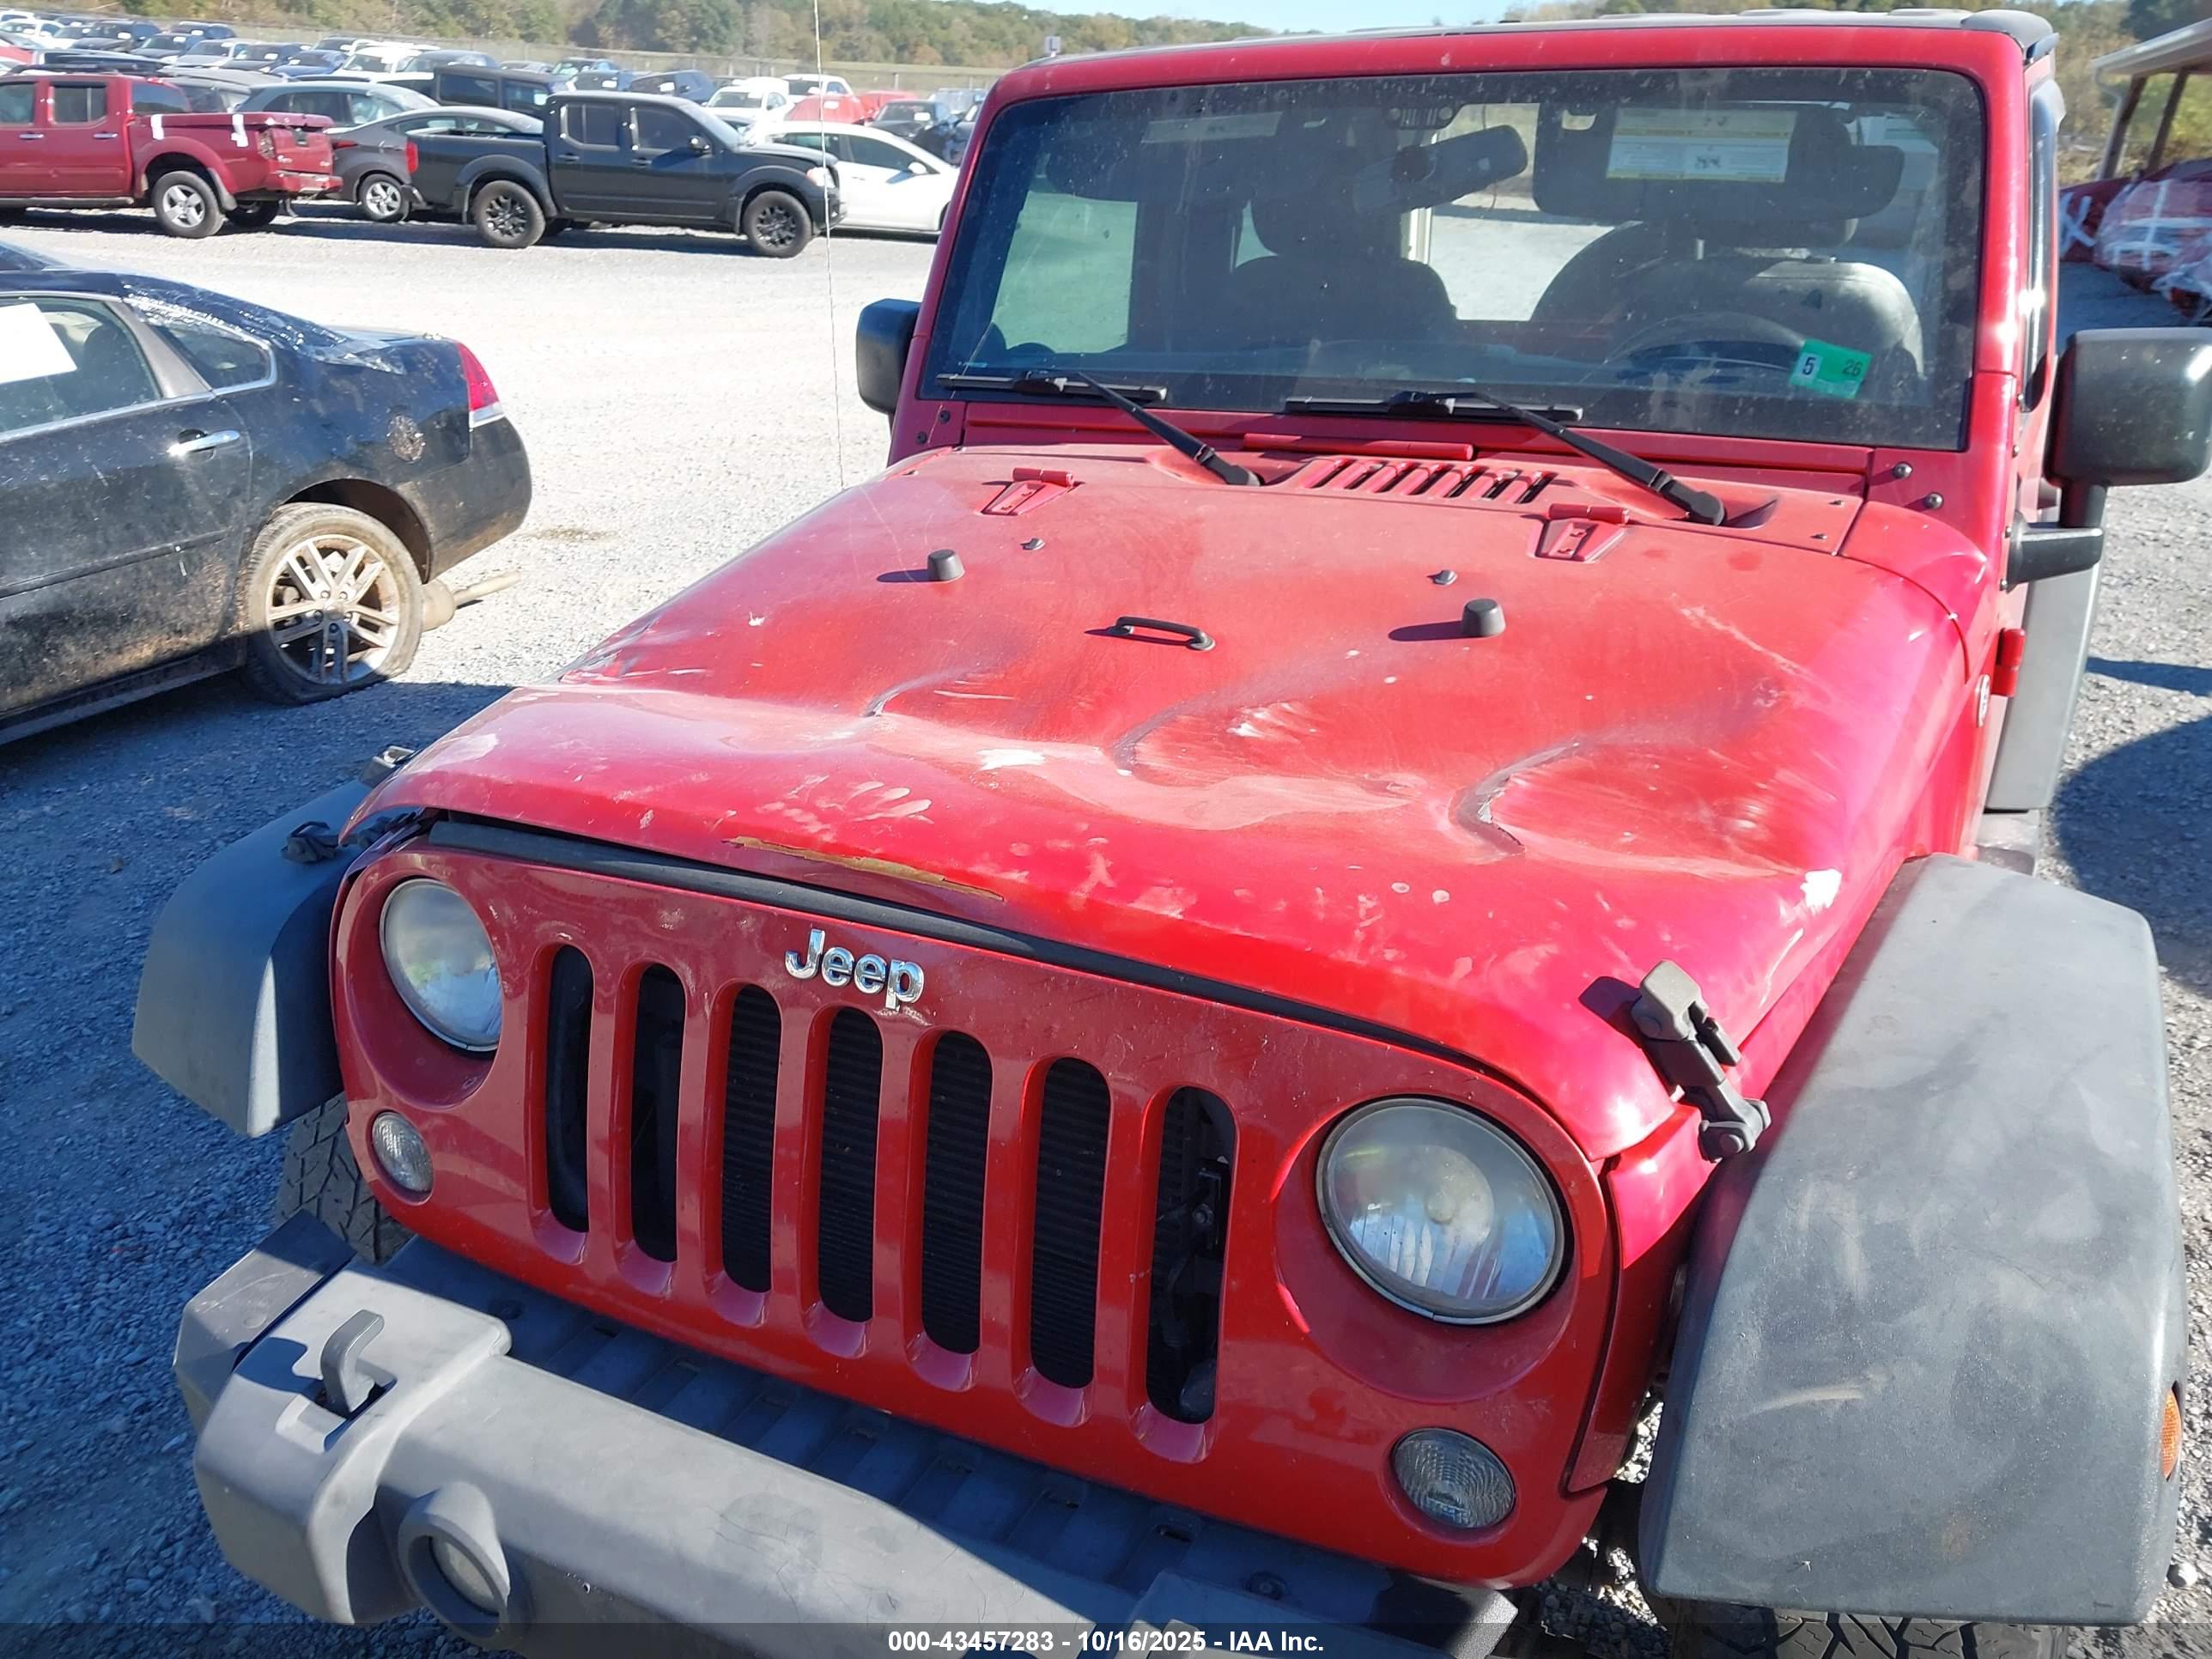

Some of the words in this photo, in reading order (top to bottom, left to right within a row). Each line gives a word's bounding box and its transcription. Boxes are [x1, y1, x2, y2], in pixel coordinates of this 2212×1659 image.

[1802, 356, 1815, 375] 5
[1842, 359, 1863, 377] 26
[785, 929, 925, 1010] Jeep
